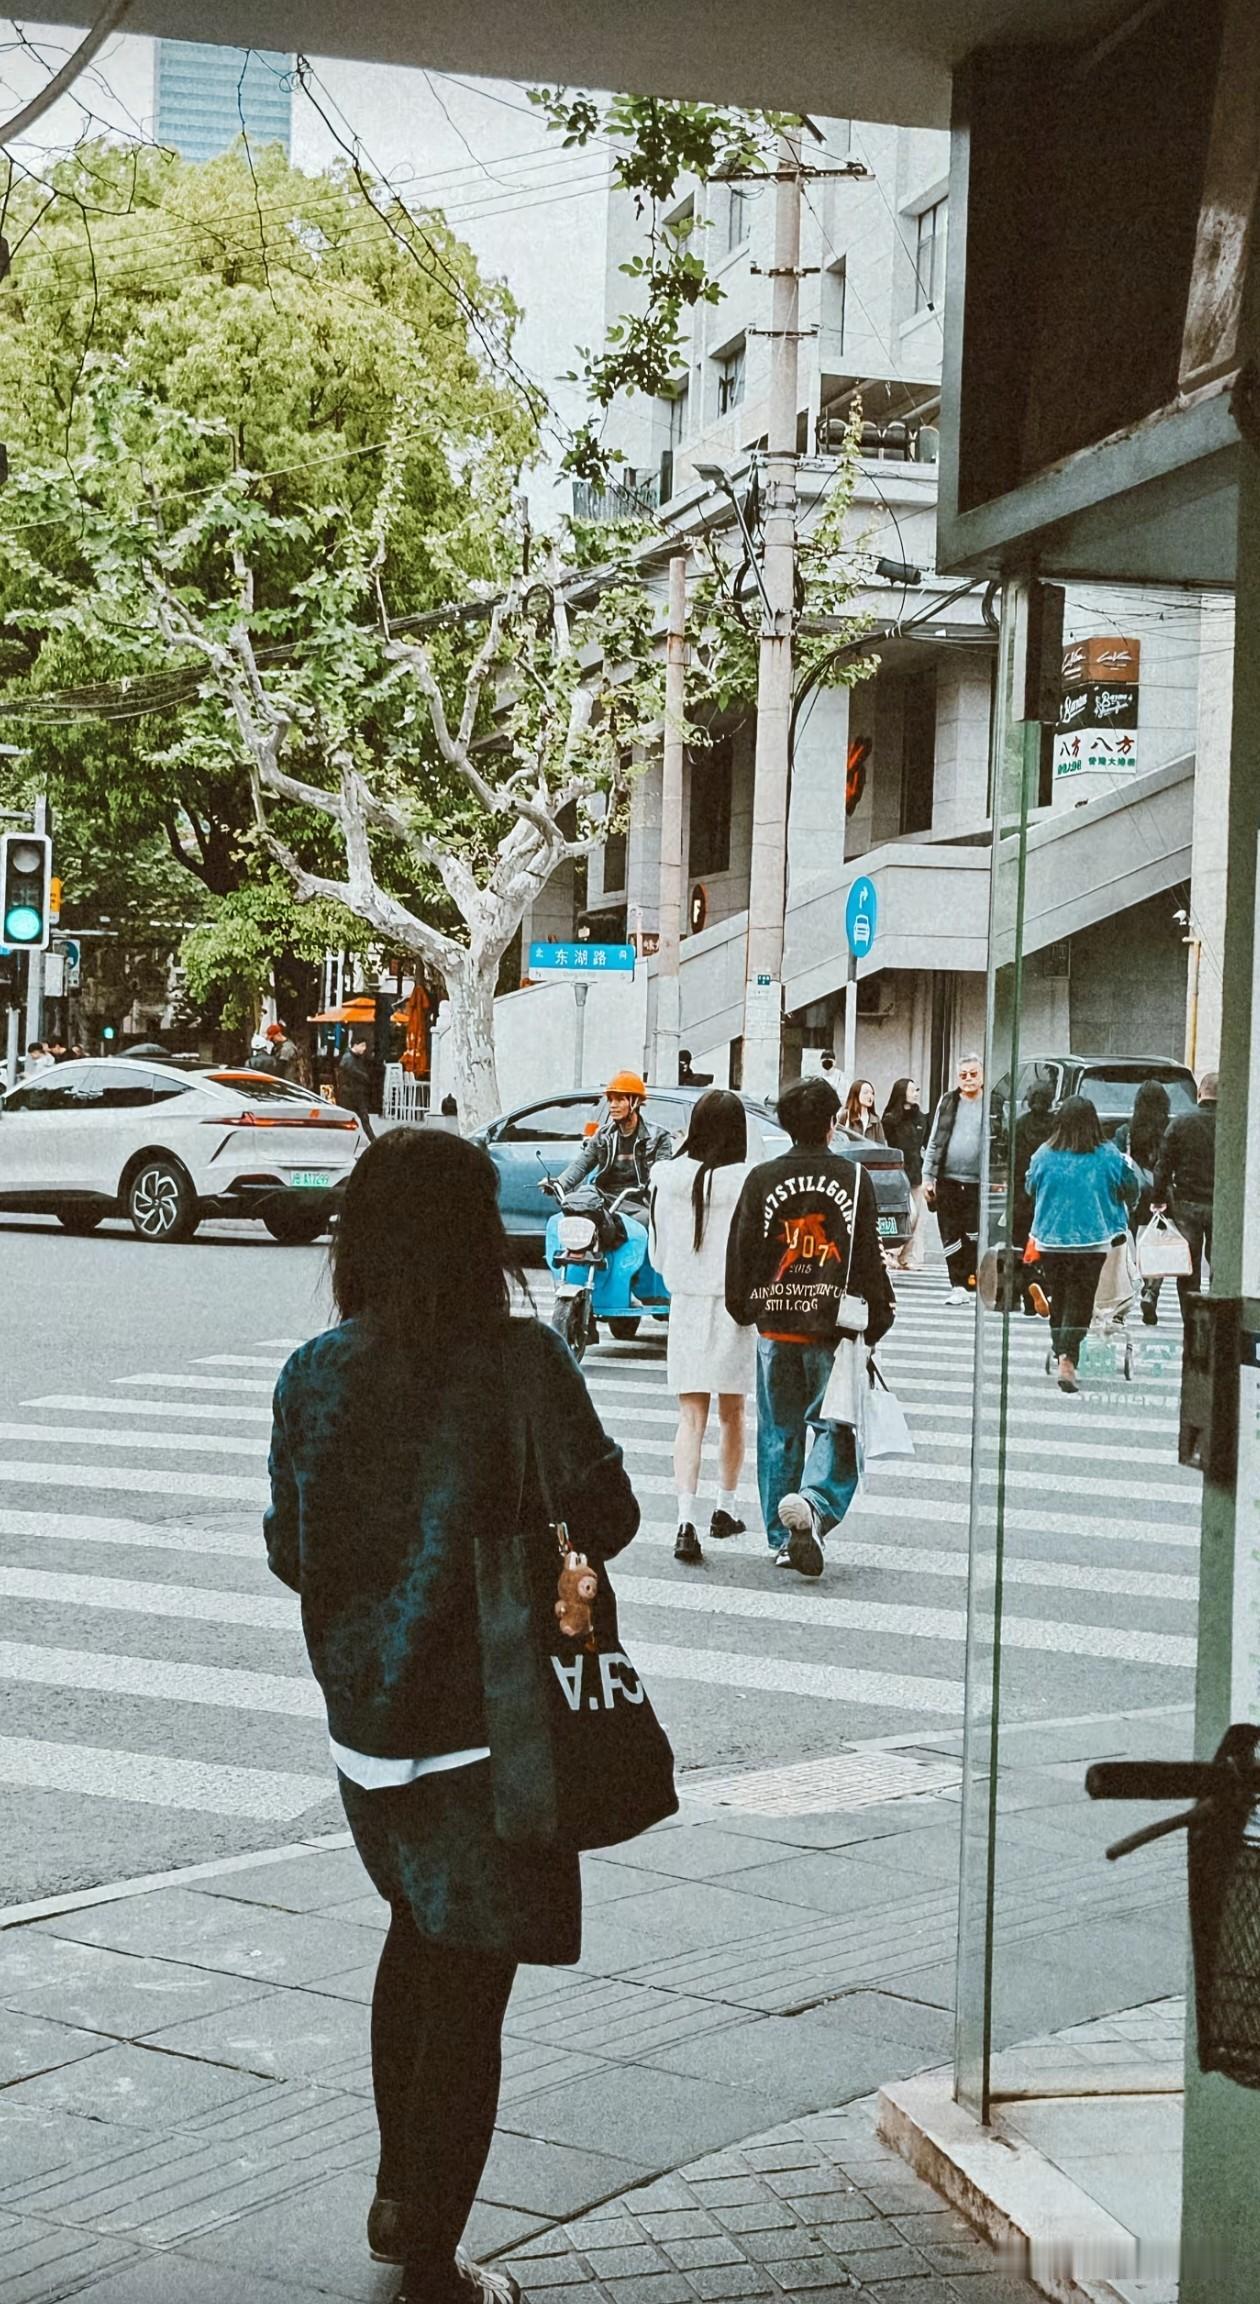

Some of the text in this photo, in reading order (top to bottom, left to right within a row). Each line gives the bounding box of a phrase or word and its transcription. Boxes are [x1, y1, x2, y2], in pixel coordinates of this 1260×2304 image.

[1090, 735, 1135, 755] 八方
[554, 948, 607, 966] 东湖路
